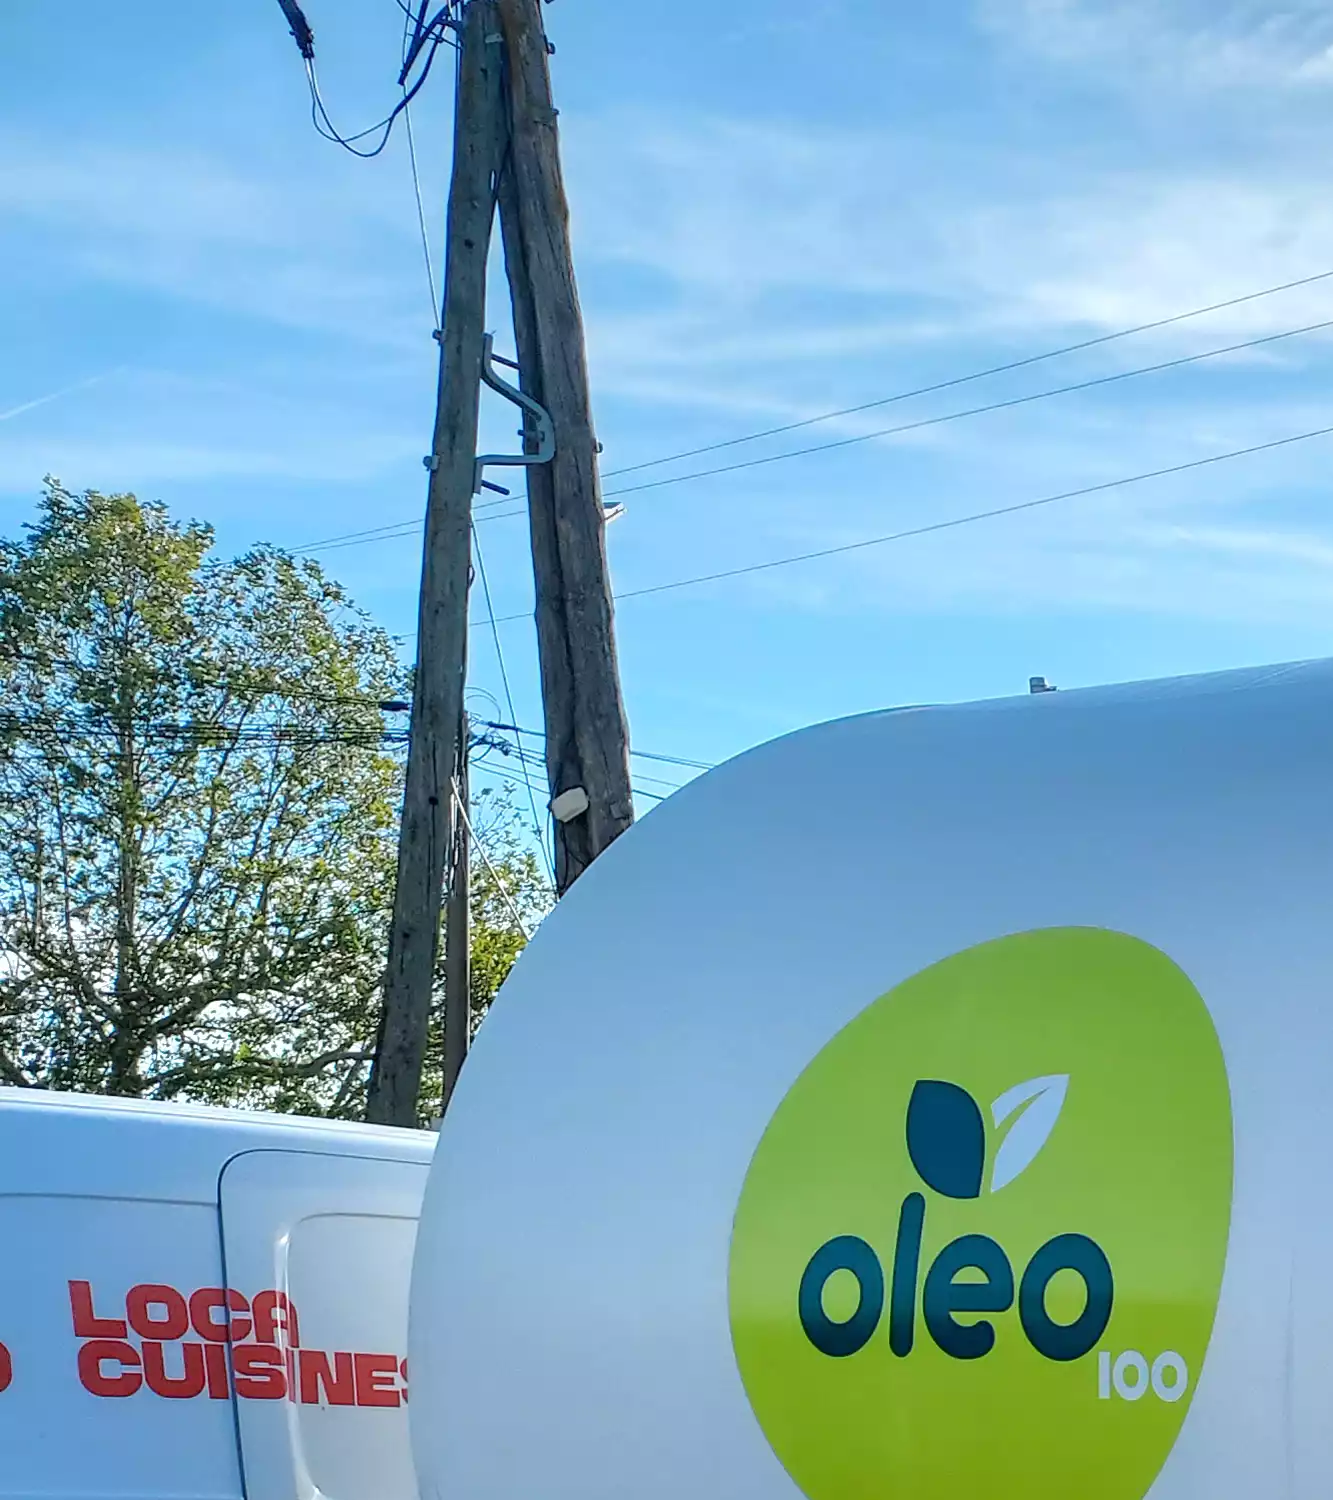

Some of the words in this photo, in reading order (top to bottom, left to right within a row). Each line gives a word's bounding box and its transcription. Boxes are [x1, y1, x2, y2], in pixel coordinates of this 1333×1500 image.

[797, 1191, 1115, 1362] oleo
[67, 1279, 300, 1349] LOCA
[77, 1339, 408, 1408] CUISINE
[1097, 1349, 1189, 1403] 100
